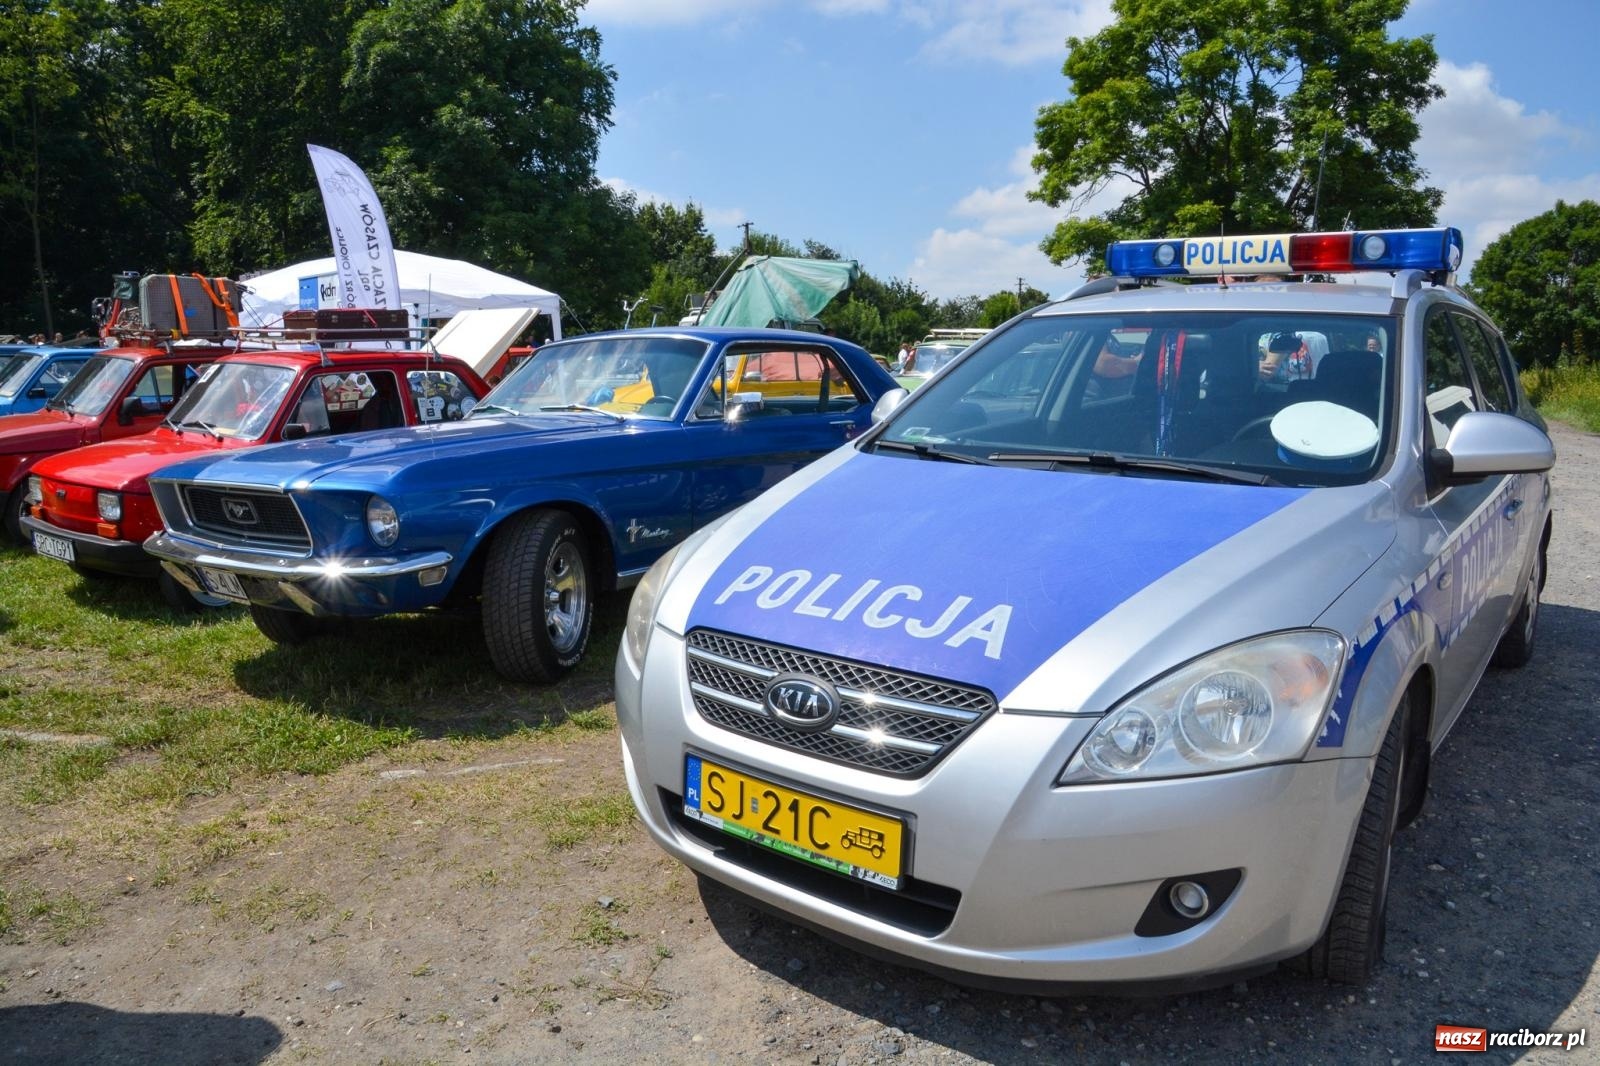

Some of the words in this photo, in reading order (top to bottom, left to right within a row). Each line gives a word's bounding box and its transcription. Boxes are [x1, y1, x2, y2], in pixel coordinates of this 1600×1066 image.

[1186, 239, 1286, 266] POLICJA
[713, 565, 1013, 660] POLICJA
[776, 687, 819, 717] KIA
[688, 787, 700, 801] PL
[707, 771, 744, 820] SJ
[762, 790, 832, 850] 21C
